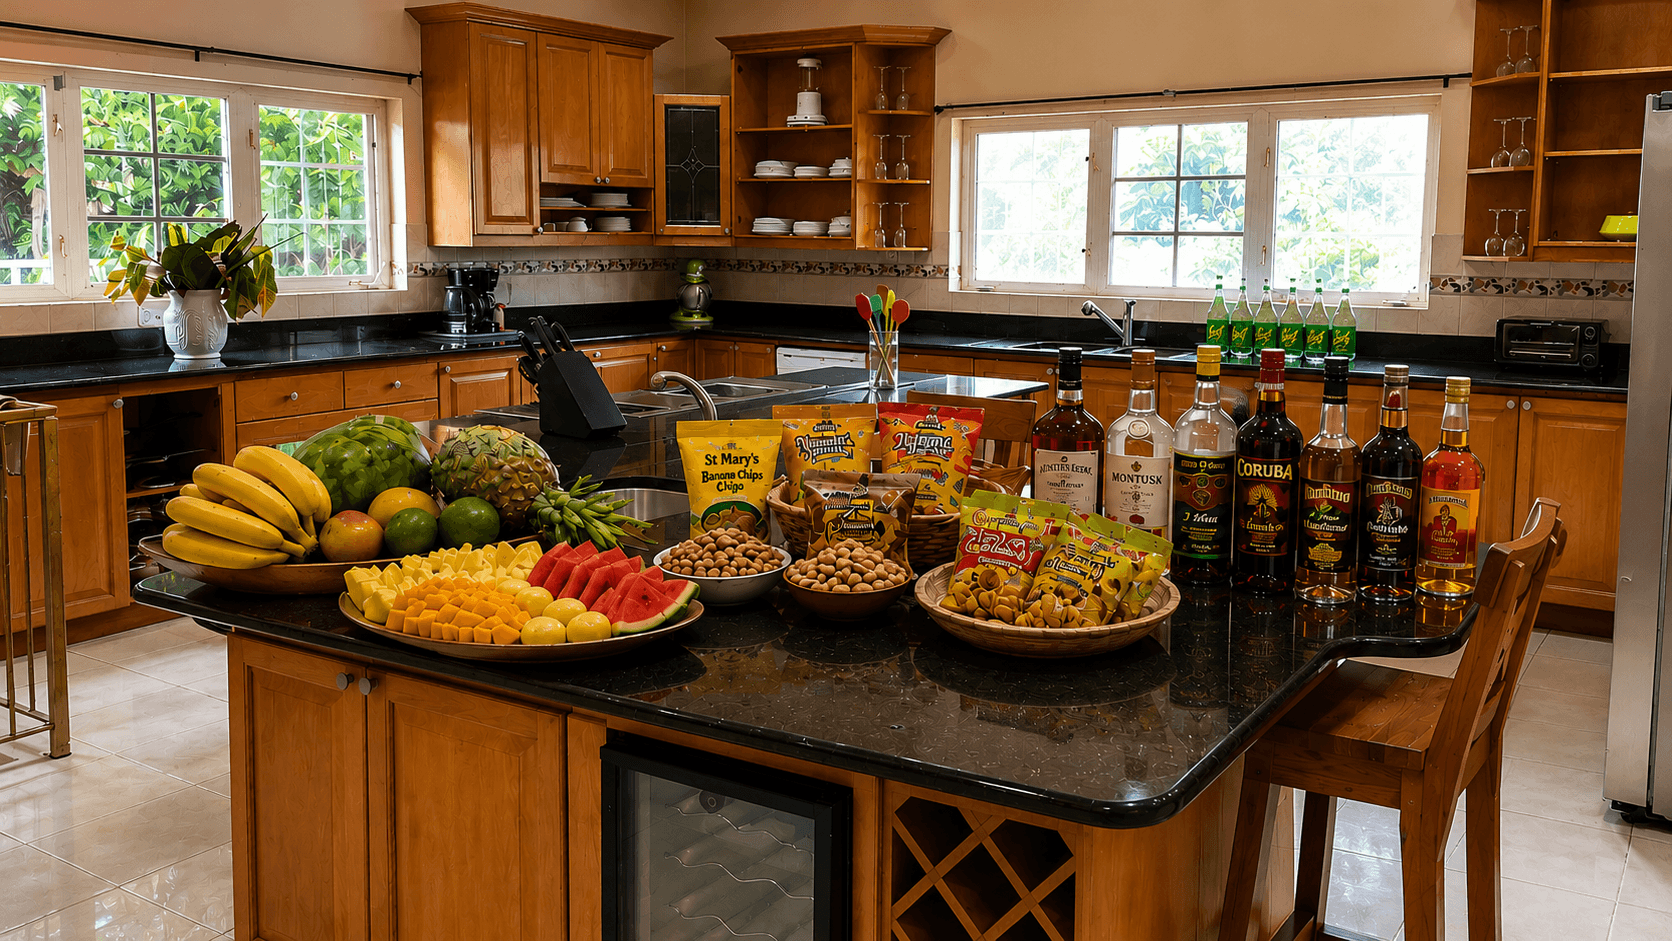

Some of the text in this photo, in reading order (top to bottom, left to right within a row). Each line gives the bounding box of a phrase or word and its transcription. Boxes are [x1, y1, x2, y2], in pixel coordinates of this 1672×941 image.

[705, 453, 759, 467] St Mary's
[737, 469, 763, 482] Chips
[1237, 458, 1293, 481] CORUBA
[1111, 472, 1163, 485] MONTUSK
